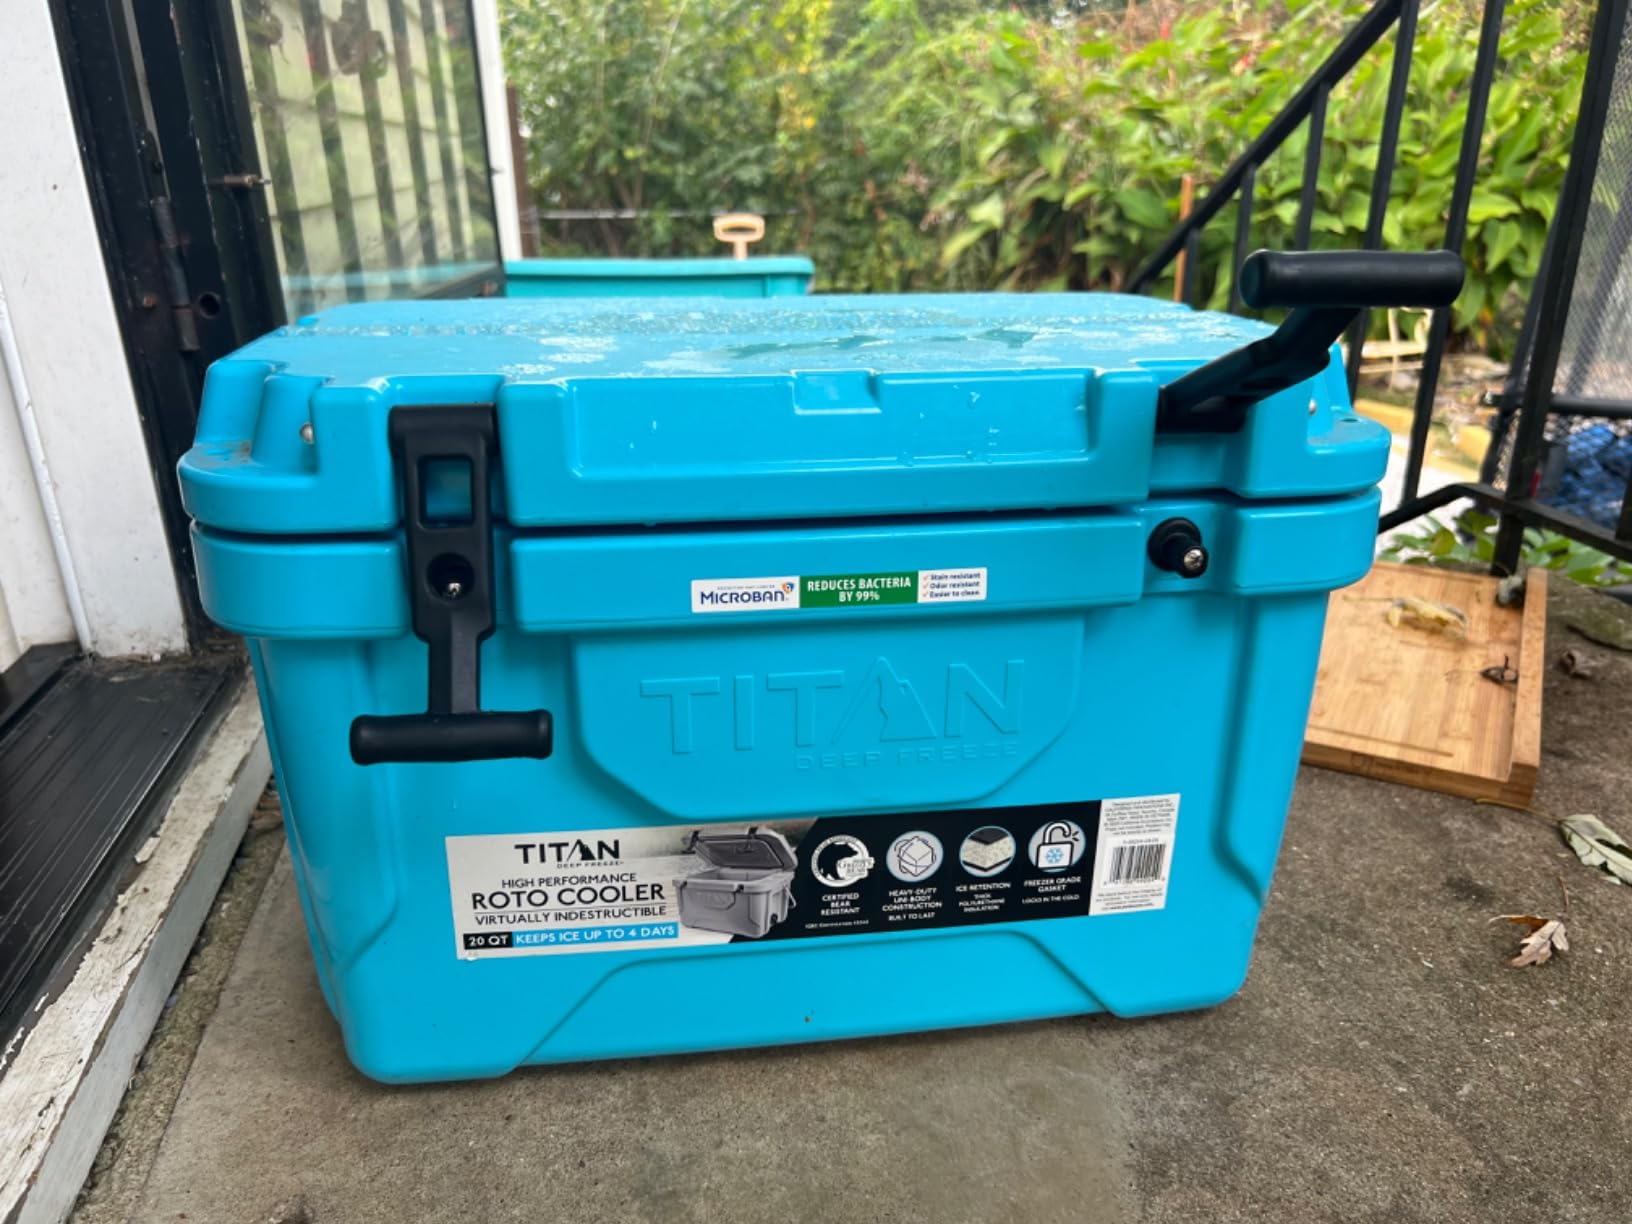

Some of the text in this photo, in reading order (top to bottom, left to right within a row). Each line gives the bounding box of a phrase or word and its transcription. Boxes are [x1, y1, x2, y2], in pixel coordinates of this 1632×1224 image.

[930, 572, 981, 581] Stain resistant
[807, 576, 912, 592] REDUCES BACTERIA
[930, 580, 980, 590] Odor resistant
[700, 590, 785, 605] MICROBAN
[839, 590, 880, 602] BY 99%
[929, 590, 951, 598] Easier
[960, 589, 980, 597] clean
[640, 655, 1025, 754] TITAN
[796, 750, 881, 770] DEEP
[513, 838, 621, 864] TITAN
[501, 872, 637, 889] HIGH PERFORMANCE
[969, 882, 1011, 891] RETENTION
[1023, 876, 1081, 887] FREEZER GRADE
[1037, 884, 1067, 893] GASKET
[471, 883, 666, 910] ROTO COOLER
[822, 892, 860, 901] CERTIFIED
[820, 907, 860, 916] RESISTANT
[882, 902, 942, 911] CONSTRUCTION
[475, 905, 667, 926] VIRTUALLY INDESTRUCTIBLE
[468, 934, 509, 946] 20 QT
[515, 925, 676, 944] KEEPS ICE UP TO 4 DAYS
